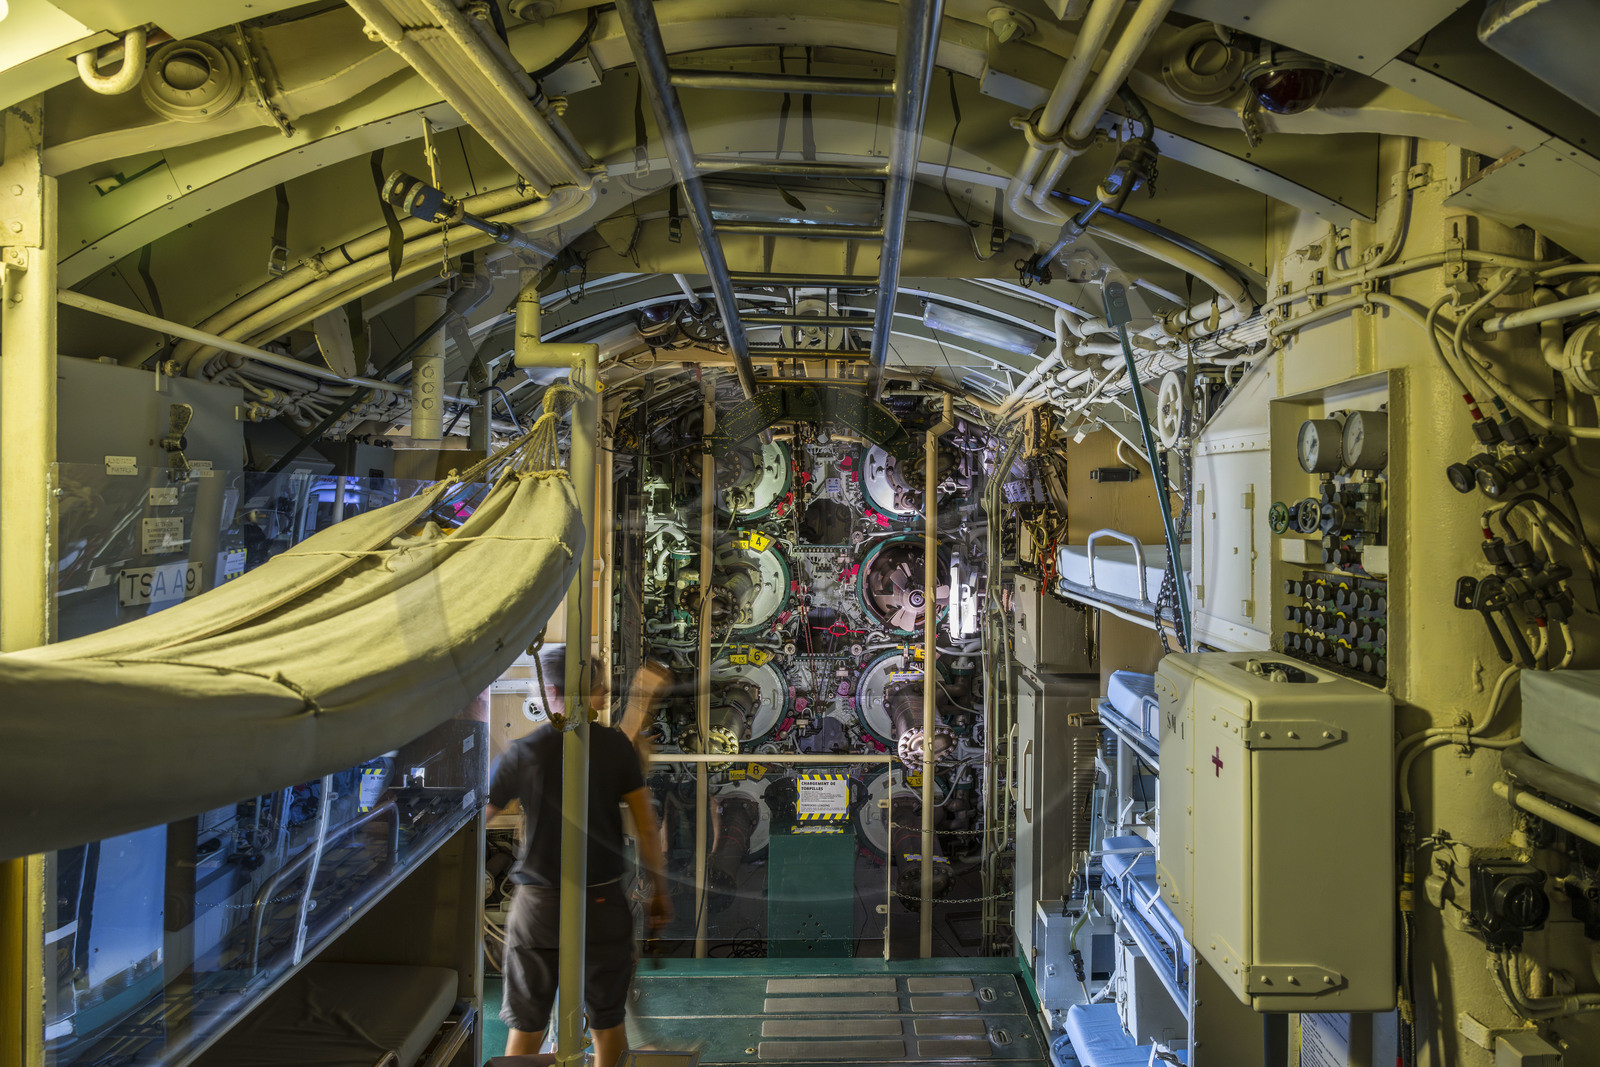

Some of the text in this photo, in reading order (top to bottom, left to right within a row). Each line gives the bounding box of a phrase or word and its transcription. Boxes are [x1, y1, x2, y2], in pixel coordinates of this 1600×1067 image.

[756, 536, 762, 546] 4
[126, 568, 196, 600] TSA A9
[754, 650, 760, 660] 6
[920, 651, 925, 660] 5
[752, 765, 760, 776] 8
